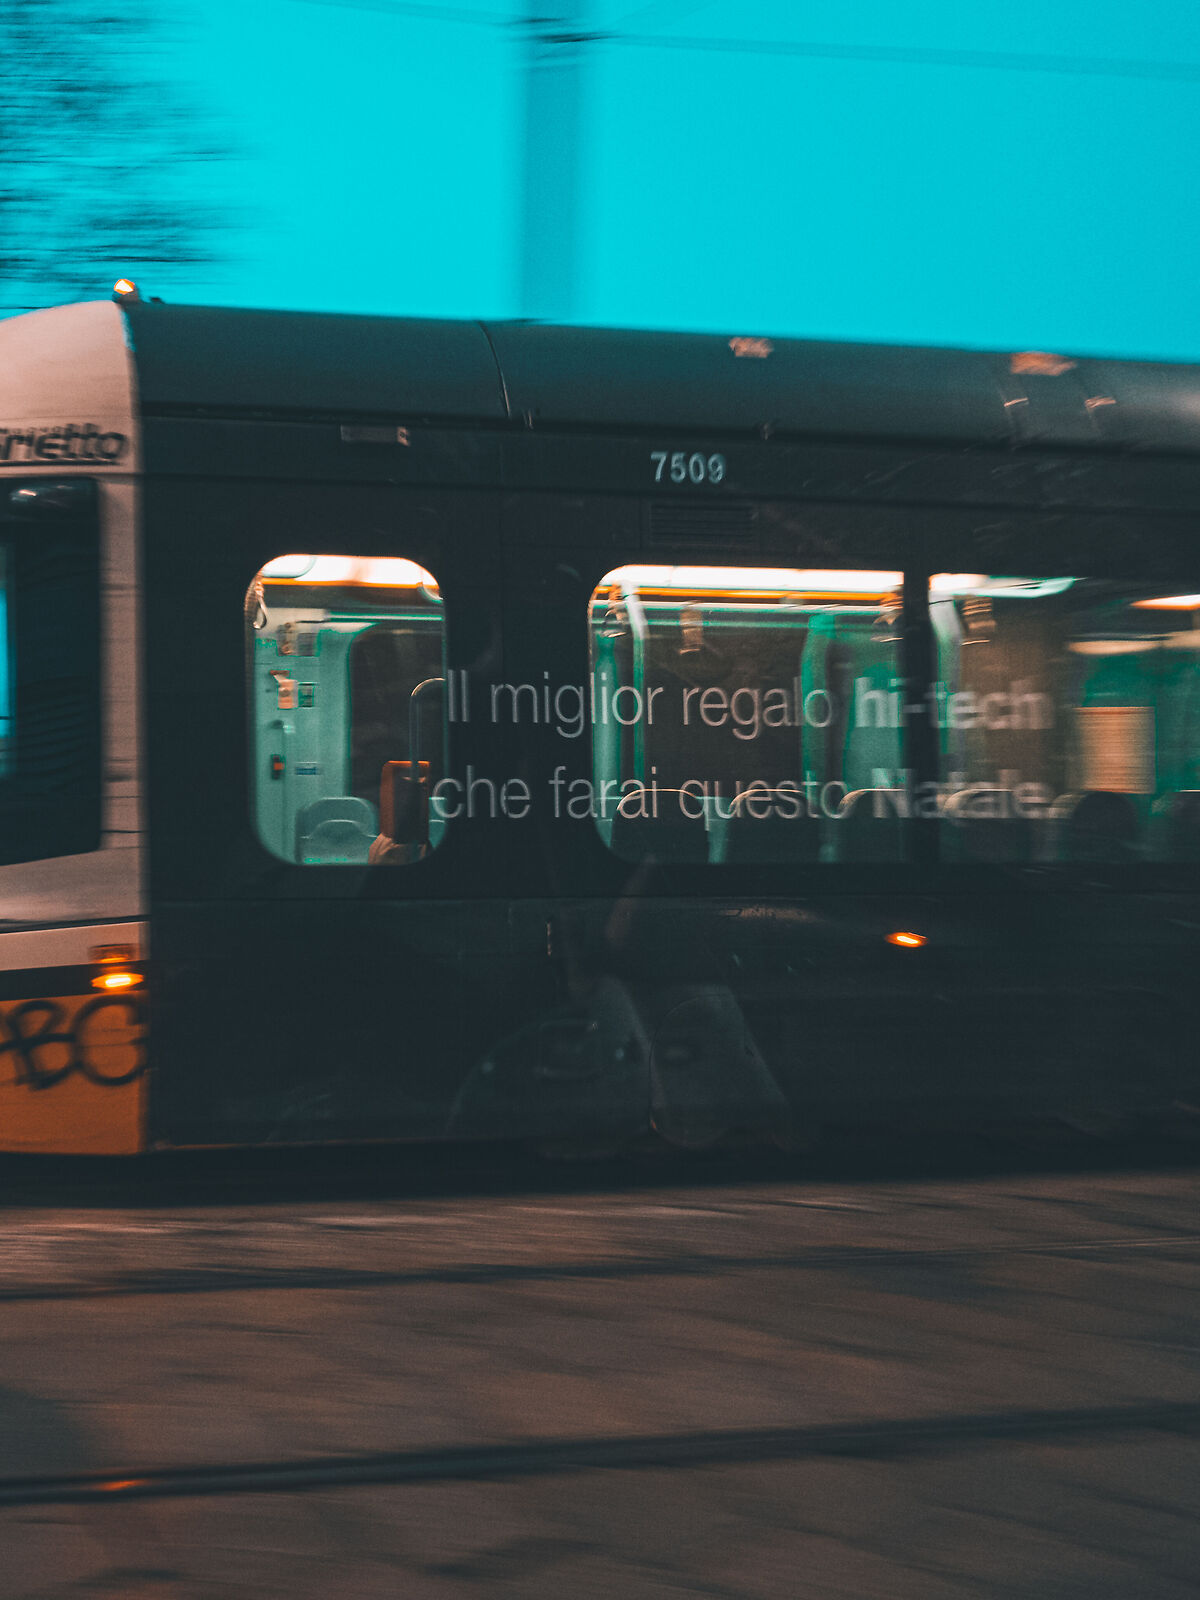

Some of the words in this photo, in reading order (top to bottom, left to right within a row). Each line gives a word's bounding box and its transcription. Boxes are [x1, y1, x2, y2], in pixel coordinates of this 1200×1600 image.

[650, 450, 726, 483] 7509
[448, 669, 469, 722] Il
[490, 671, 664, 738] miglior
[682, 676, 833, 740] regalo
[854, 676, 1052, 730] hi-tech
[432, 764, 531, 819] che
[548, 765, 658, 819] farai
[678, 770, 849, 832] questo
